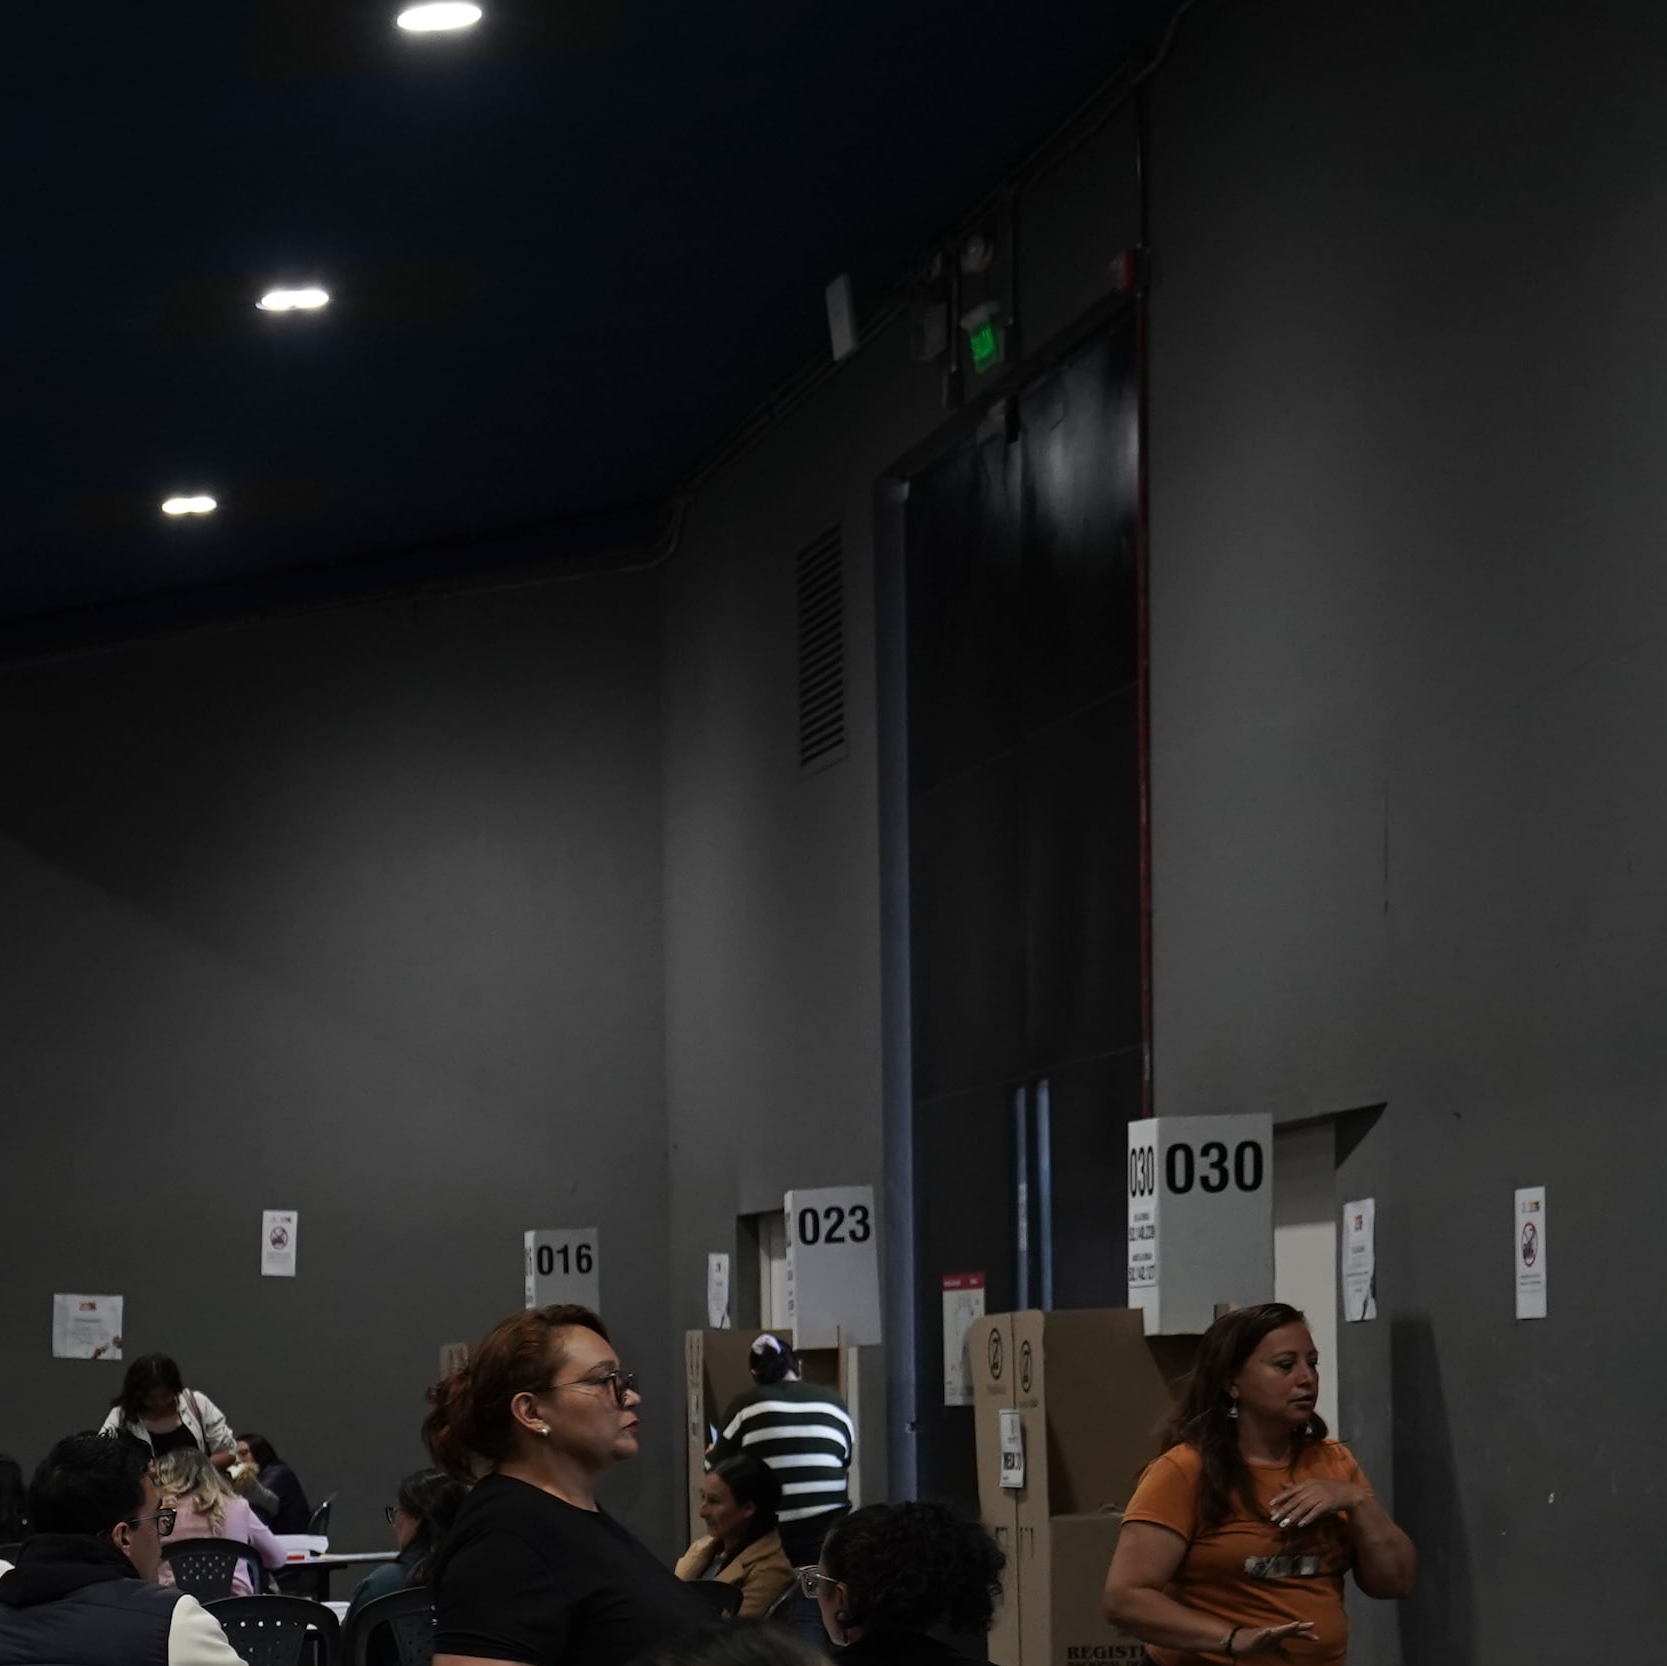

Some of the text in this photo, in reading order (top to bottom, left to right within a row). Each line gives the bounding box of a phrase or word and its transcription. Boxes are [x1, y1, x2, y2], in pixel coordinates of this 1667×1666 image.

[1130, 1145, 1154, 1197] 030
[1166, 1140, 1263, 1194] 030
[798, 1204, 871, 1246] 023
[537, 1243, 593, 1275] 016
